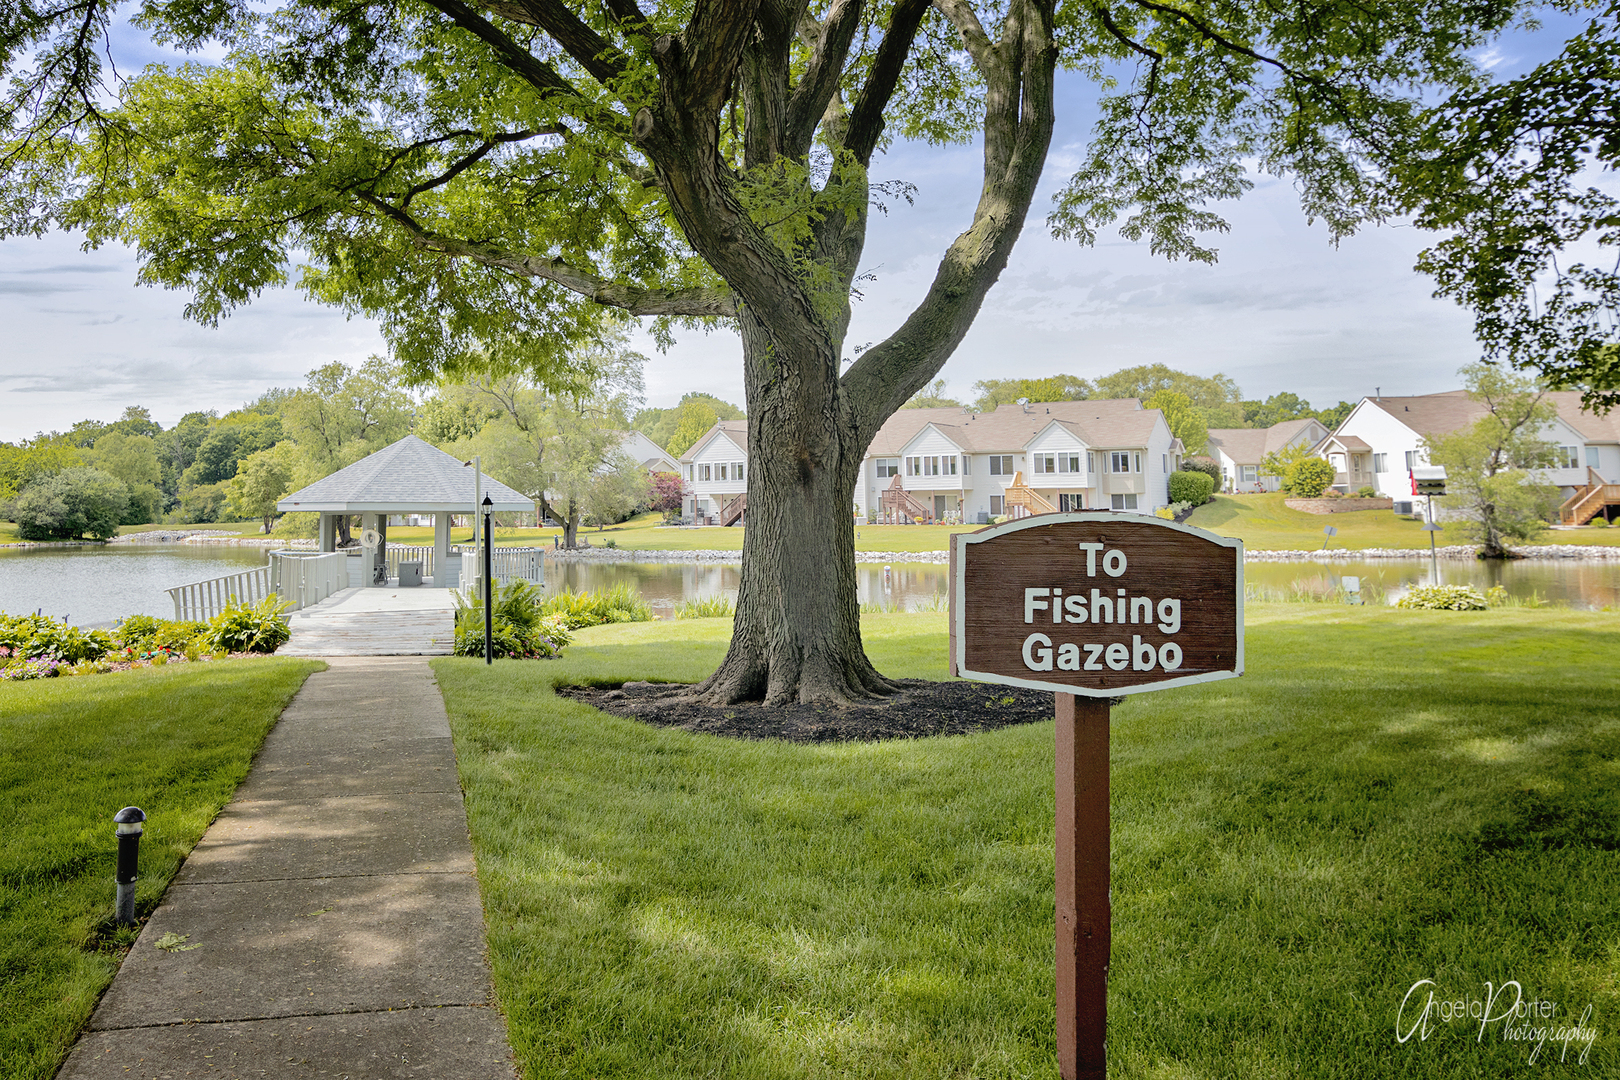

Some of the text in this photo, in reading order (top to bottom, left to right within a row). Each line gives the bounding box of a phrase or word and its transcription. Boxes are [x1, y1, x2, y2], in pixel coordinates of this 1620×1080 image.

[1079, 542, 1127, 577] To
[1024, 587, 1181, 634] Fishing
[1022, 632, 1183, 672] Gazebo
